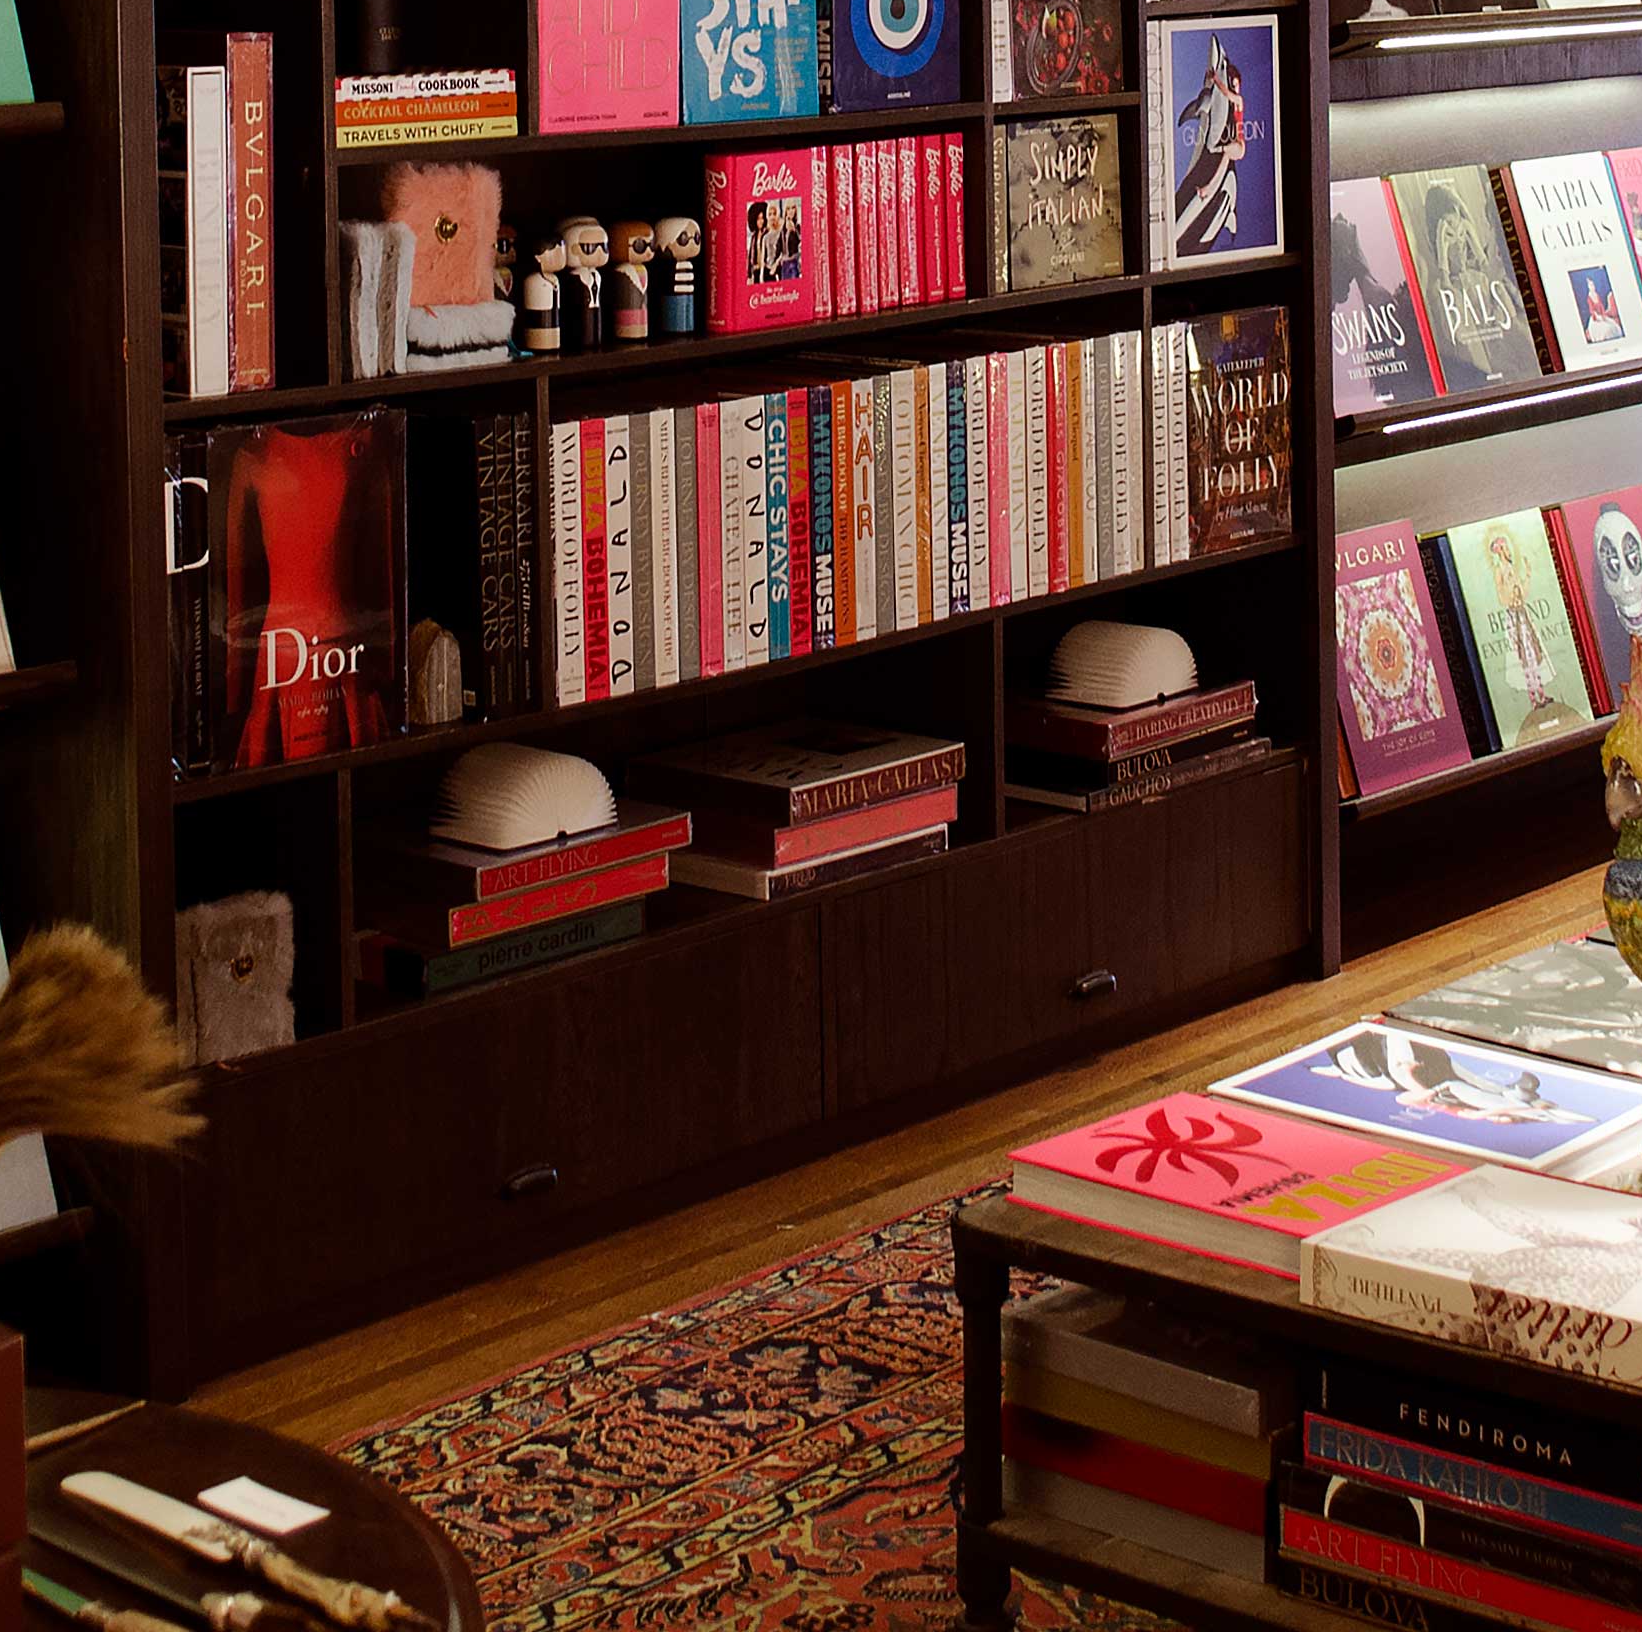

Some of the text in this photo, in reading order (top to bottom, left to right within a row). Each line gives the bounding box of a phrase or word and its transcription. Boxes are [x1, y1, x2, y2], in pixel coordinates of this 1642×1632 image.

[351, 79, 394, 96] MISSONI
[418, 76, 480, 92] COOKBOOK
[695, 25, 767, 101] YS
[342, 122, 485, 145] TRAVELS WITH CHUFY
[343, 101, 403, 121] COCKTAIL
[752, 161, 797, 198] Barbie
[926, 147, 941, 200] Barbie
[948, 143, 964, 198] Barbie
[1531, 180, 1603, 213] MARIA
[243, 100, 265, 316] BVLGARI
[1541, 220, 1613, 251] CALLAS
[1332, 303, 1405, 356] SWANS
[1439, 280, 1512, 345] BALS
[1191, 371, 1289, 419] WORLD
[855, 393, 872, 540] HAIR
[1030, 357, 1046, 553] WORLD OF FOLLY
[1224, 417, 1260, 456] OF
[948, 386, 968, 604] MYKONOS MUSE
[1203, 455, 1280, 501] FOLLY
[478, 431, 501, 653] VINTAGE CARS
[744, 407, 767, 638] DONALD
[767, 419, 789, 604] CHIC STAYS
[813, 414, 834, 634] MYKONOS MUSE
[559, 432, 581, 658] WORLD OF FOLLY
[583, 448, 607, 684] IBIZA BOHEMIA
[790, 501, 810, 651] BOHEMIA
[498, 572, 517, 650] CARS
[259, 626, 365, 691] Dior
[1136, 697, 1239, 739] DARING CREATIVITY
[801, 781, 869, 818] MARIA
[878, 759, 953, 795] CALLAS
[1110, 773, 1172, 807] GAUCHOS
[1117, 749, 1172, 781] BULOVA
[492, 845, 599, 892] ART FLYING
[477, 921, 596, 974] pierre cardin
[1212, 1171, 1316, 1212] BOHEMIA
[1237, 1150, 1452, 1225] IBIZA
[1398, 1402, 1574, 1466] FENDIROMA
[1316, 1420, 1528, 1513] FRIDA KAHLO
[1305, 1527, 1483, 1603] ART FLYING
[1297, 1567, 1435, 1632] BULOVA
